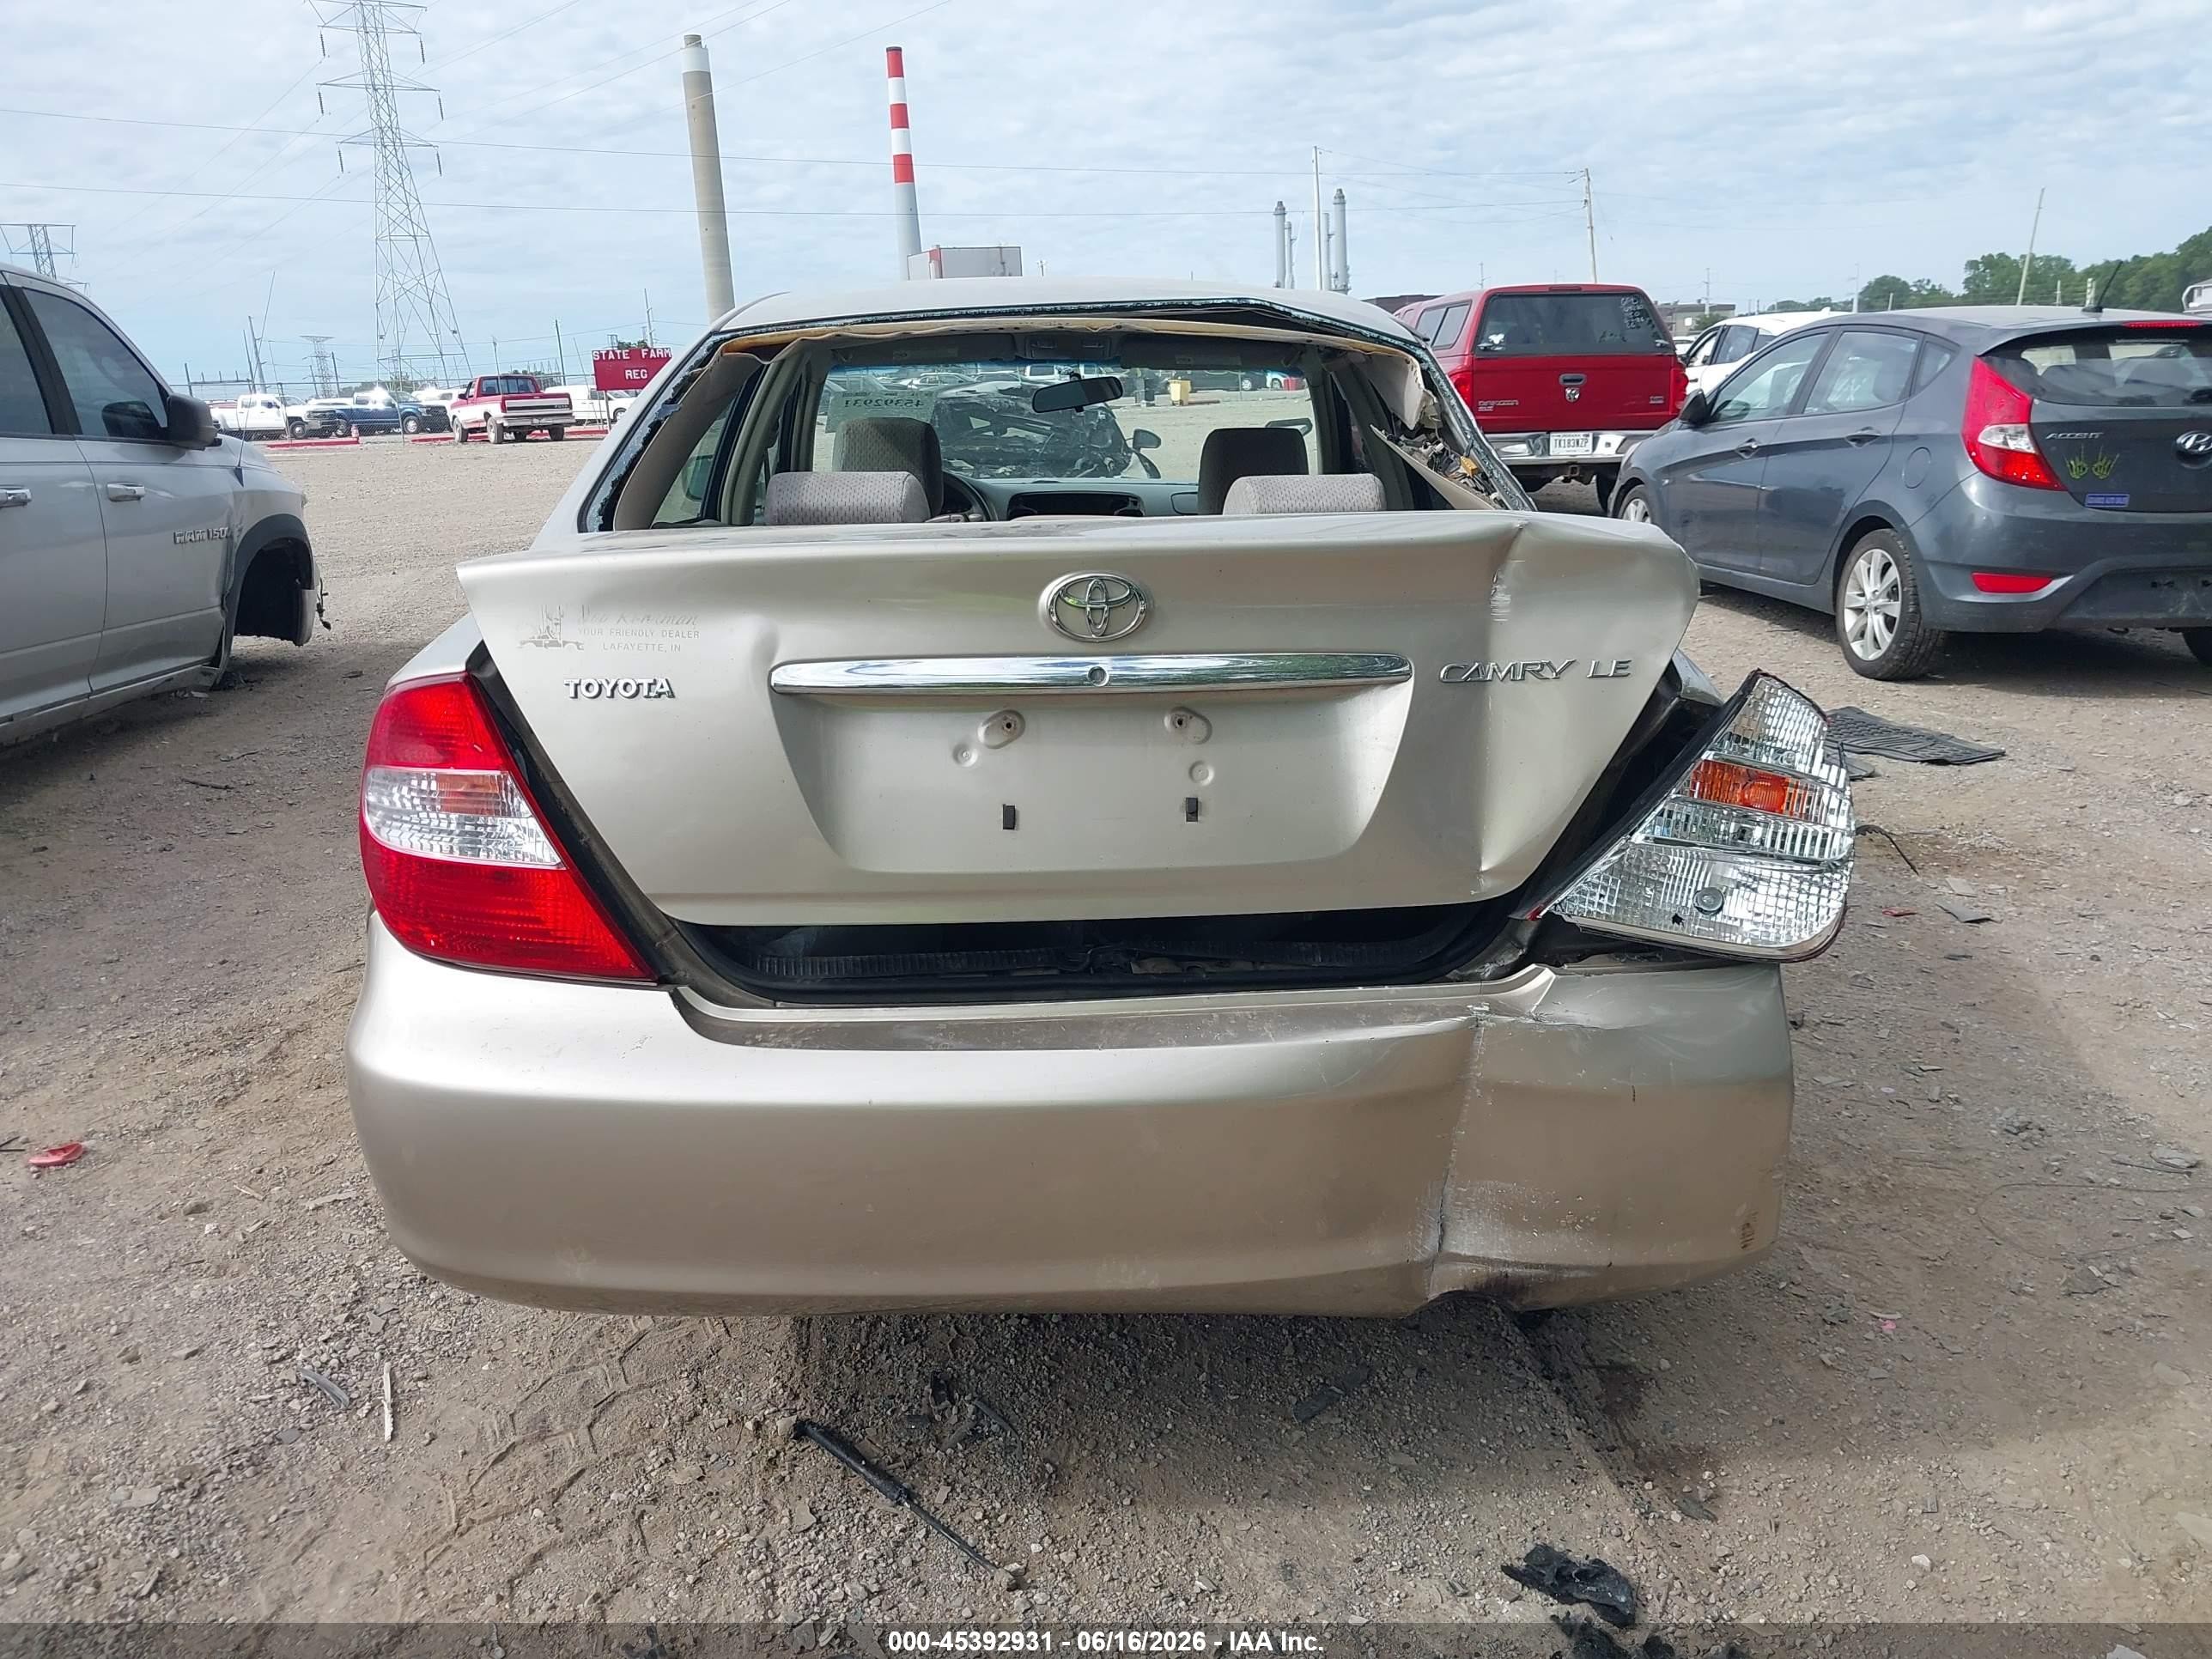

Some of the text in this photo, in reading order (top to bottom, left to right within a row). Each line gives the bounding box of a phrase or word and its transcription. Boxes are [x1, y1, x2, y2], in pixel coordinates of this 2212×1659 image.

[592, 348, 672, 360] STATE FARM
[624, 369, 648, 380] REG
[173, 529, 206, 544] RAM
[610, 629, 654, 637] FRIENDLY
[661, 629, 700, 639] DEALER
[603, 642, 681, 653] LAFAYETTE, IN
[1439, 659, 1632, 683] CAMRY LE
[563, 677, 676, 699] TOYOTA
